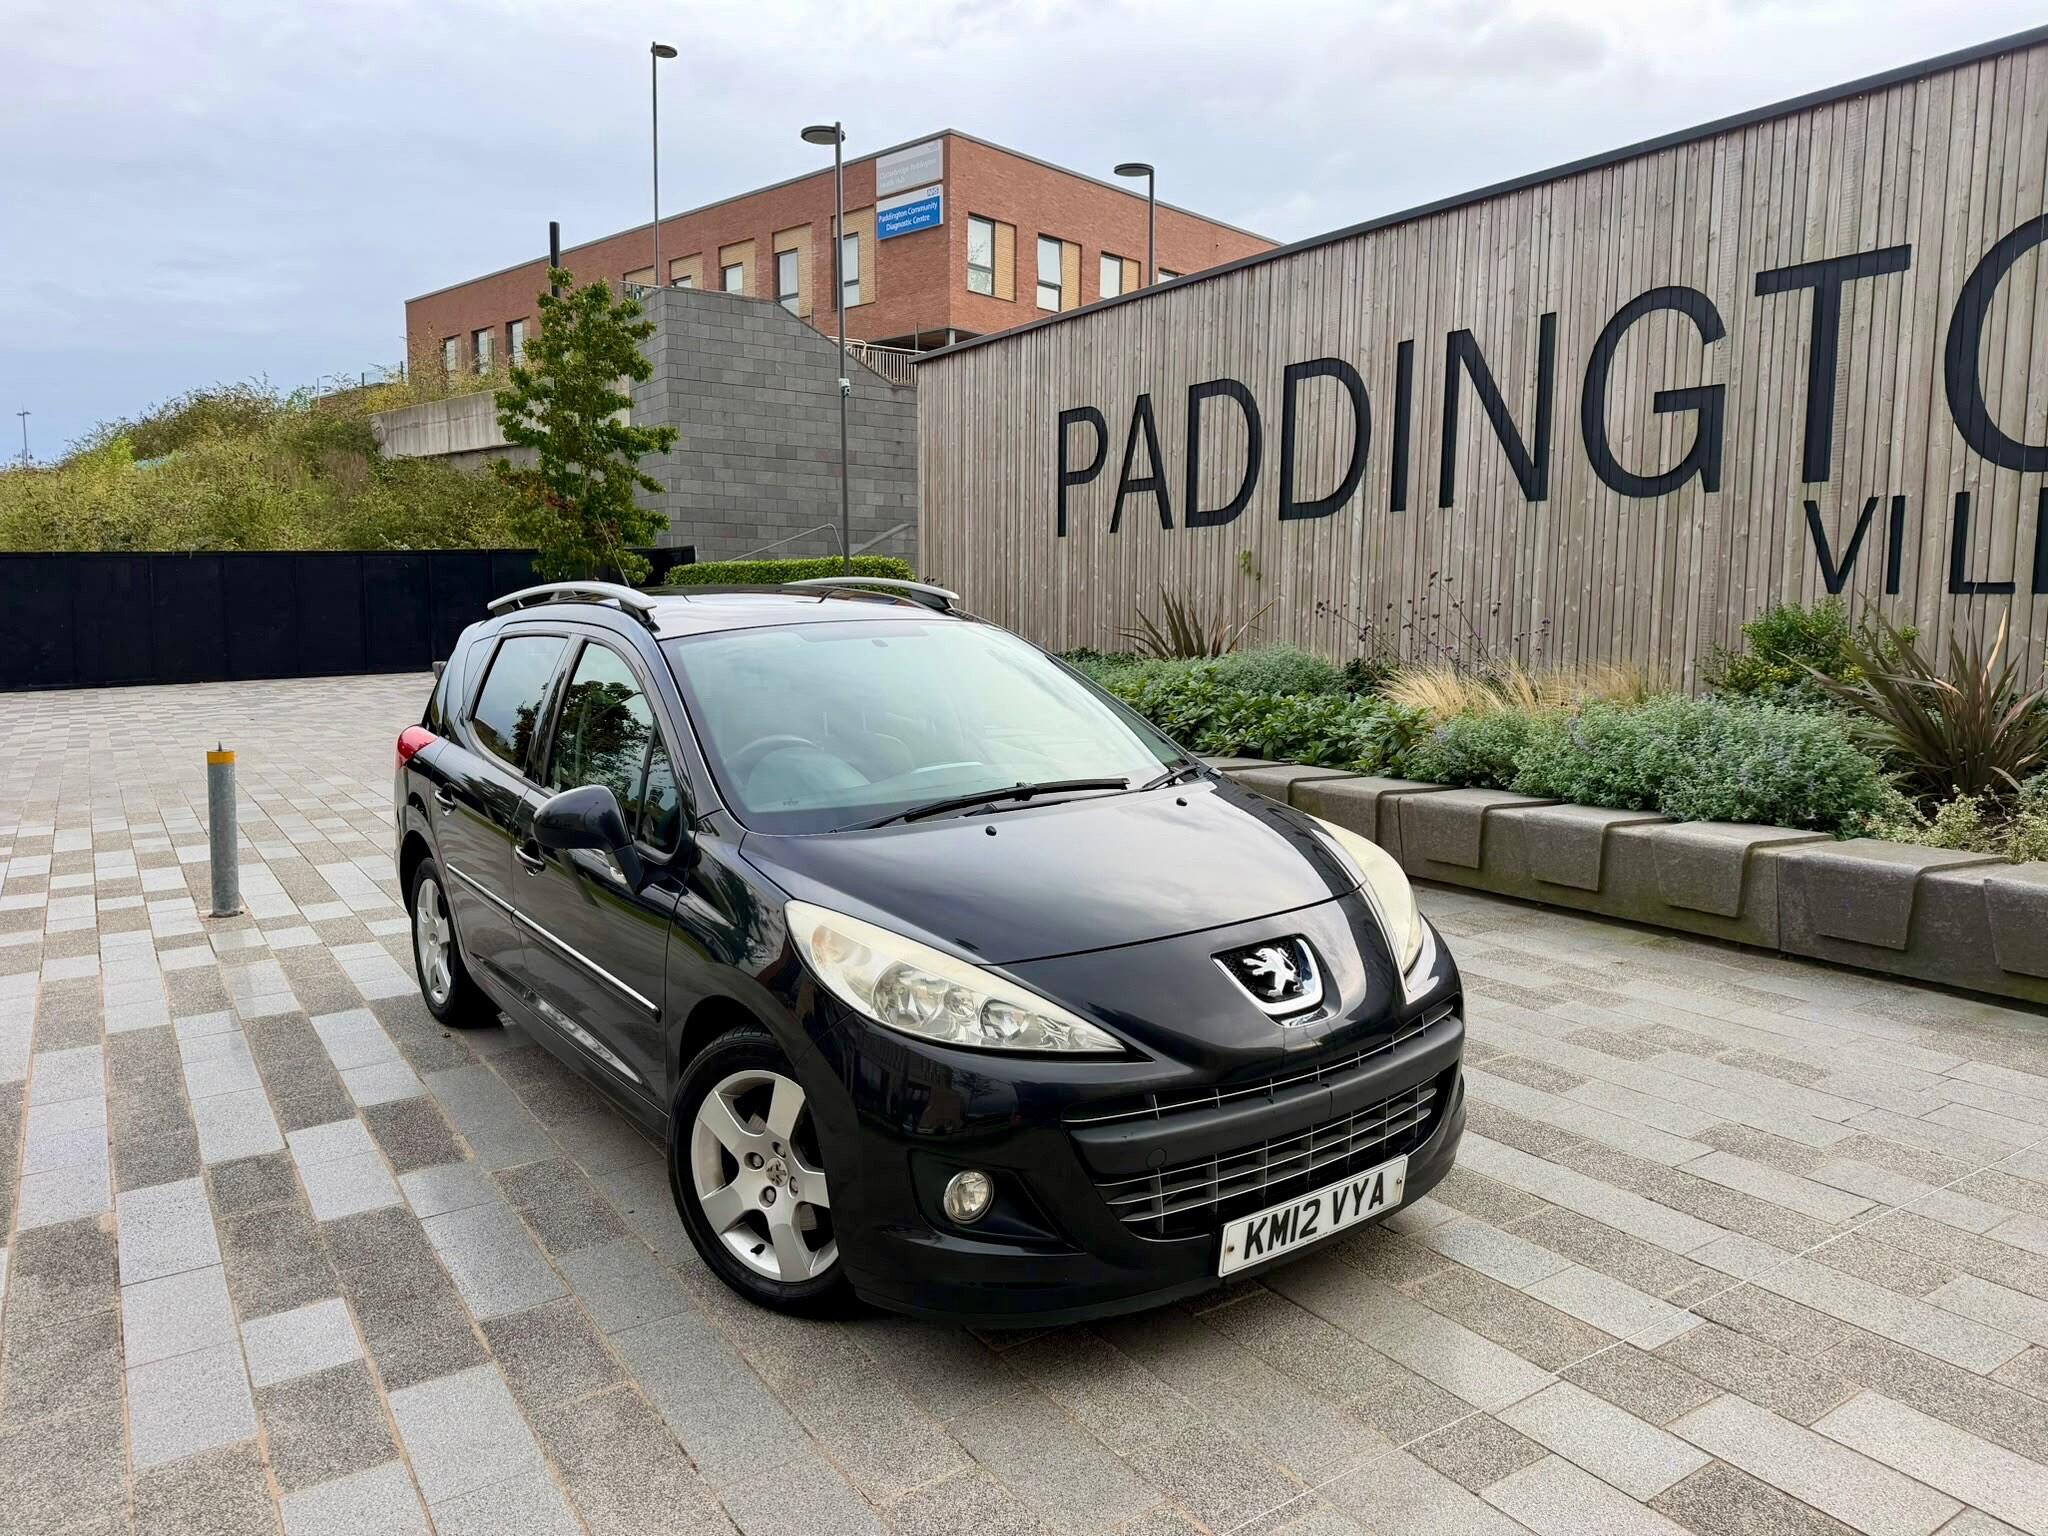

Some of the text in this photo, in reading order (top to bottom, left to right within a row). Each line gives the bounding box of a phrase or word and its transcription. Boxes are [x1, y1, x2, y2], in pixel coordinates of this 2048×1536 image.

[878, 201, 938, 223] Paddington Community
[885, 214, 930, 231] Diagnostic Centre
[1803, 487, 2048, 595] VIL
[1243, 1172, 1384, 1260] KM12 VYA
